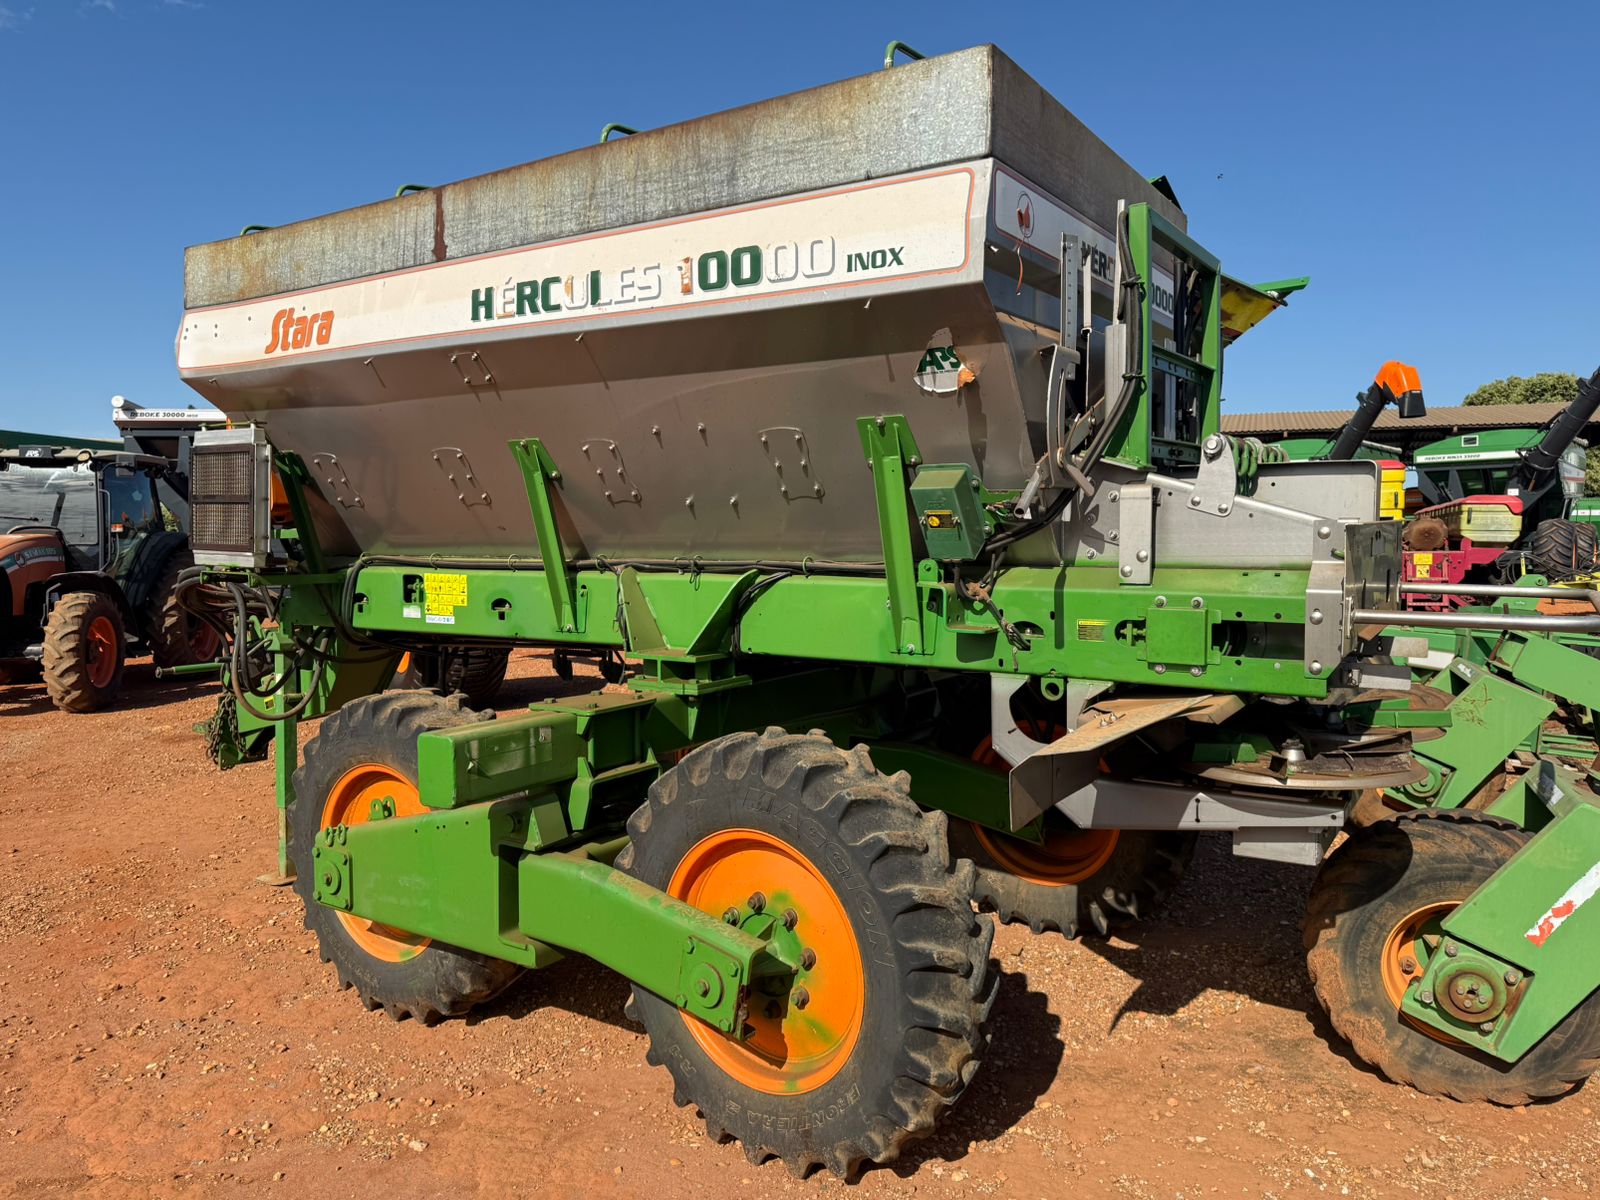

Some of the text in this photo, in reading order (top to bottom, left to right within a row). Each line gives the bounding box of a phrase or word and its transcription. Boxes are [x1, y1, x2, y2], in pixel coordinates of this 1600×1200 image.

[470, 235, 904, 323] HÉRCULES 10000 INOX
[265, 307, 335, 354] Stara
